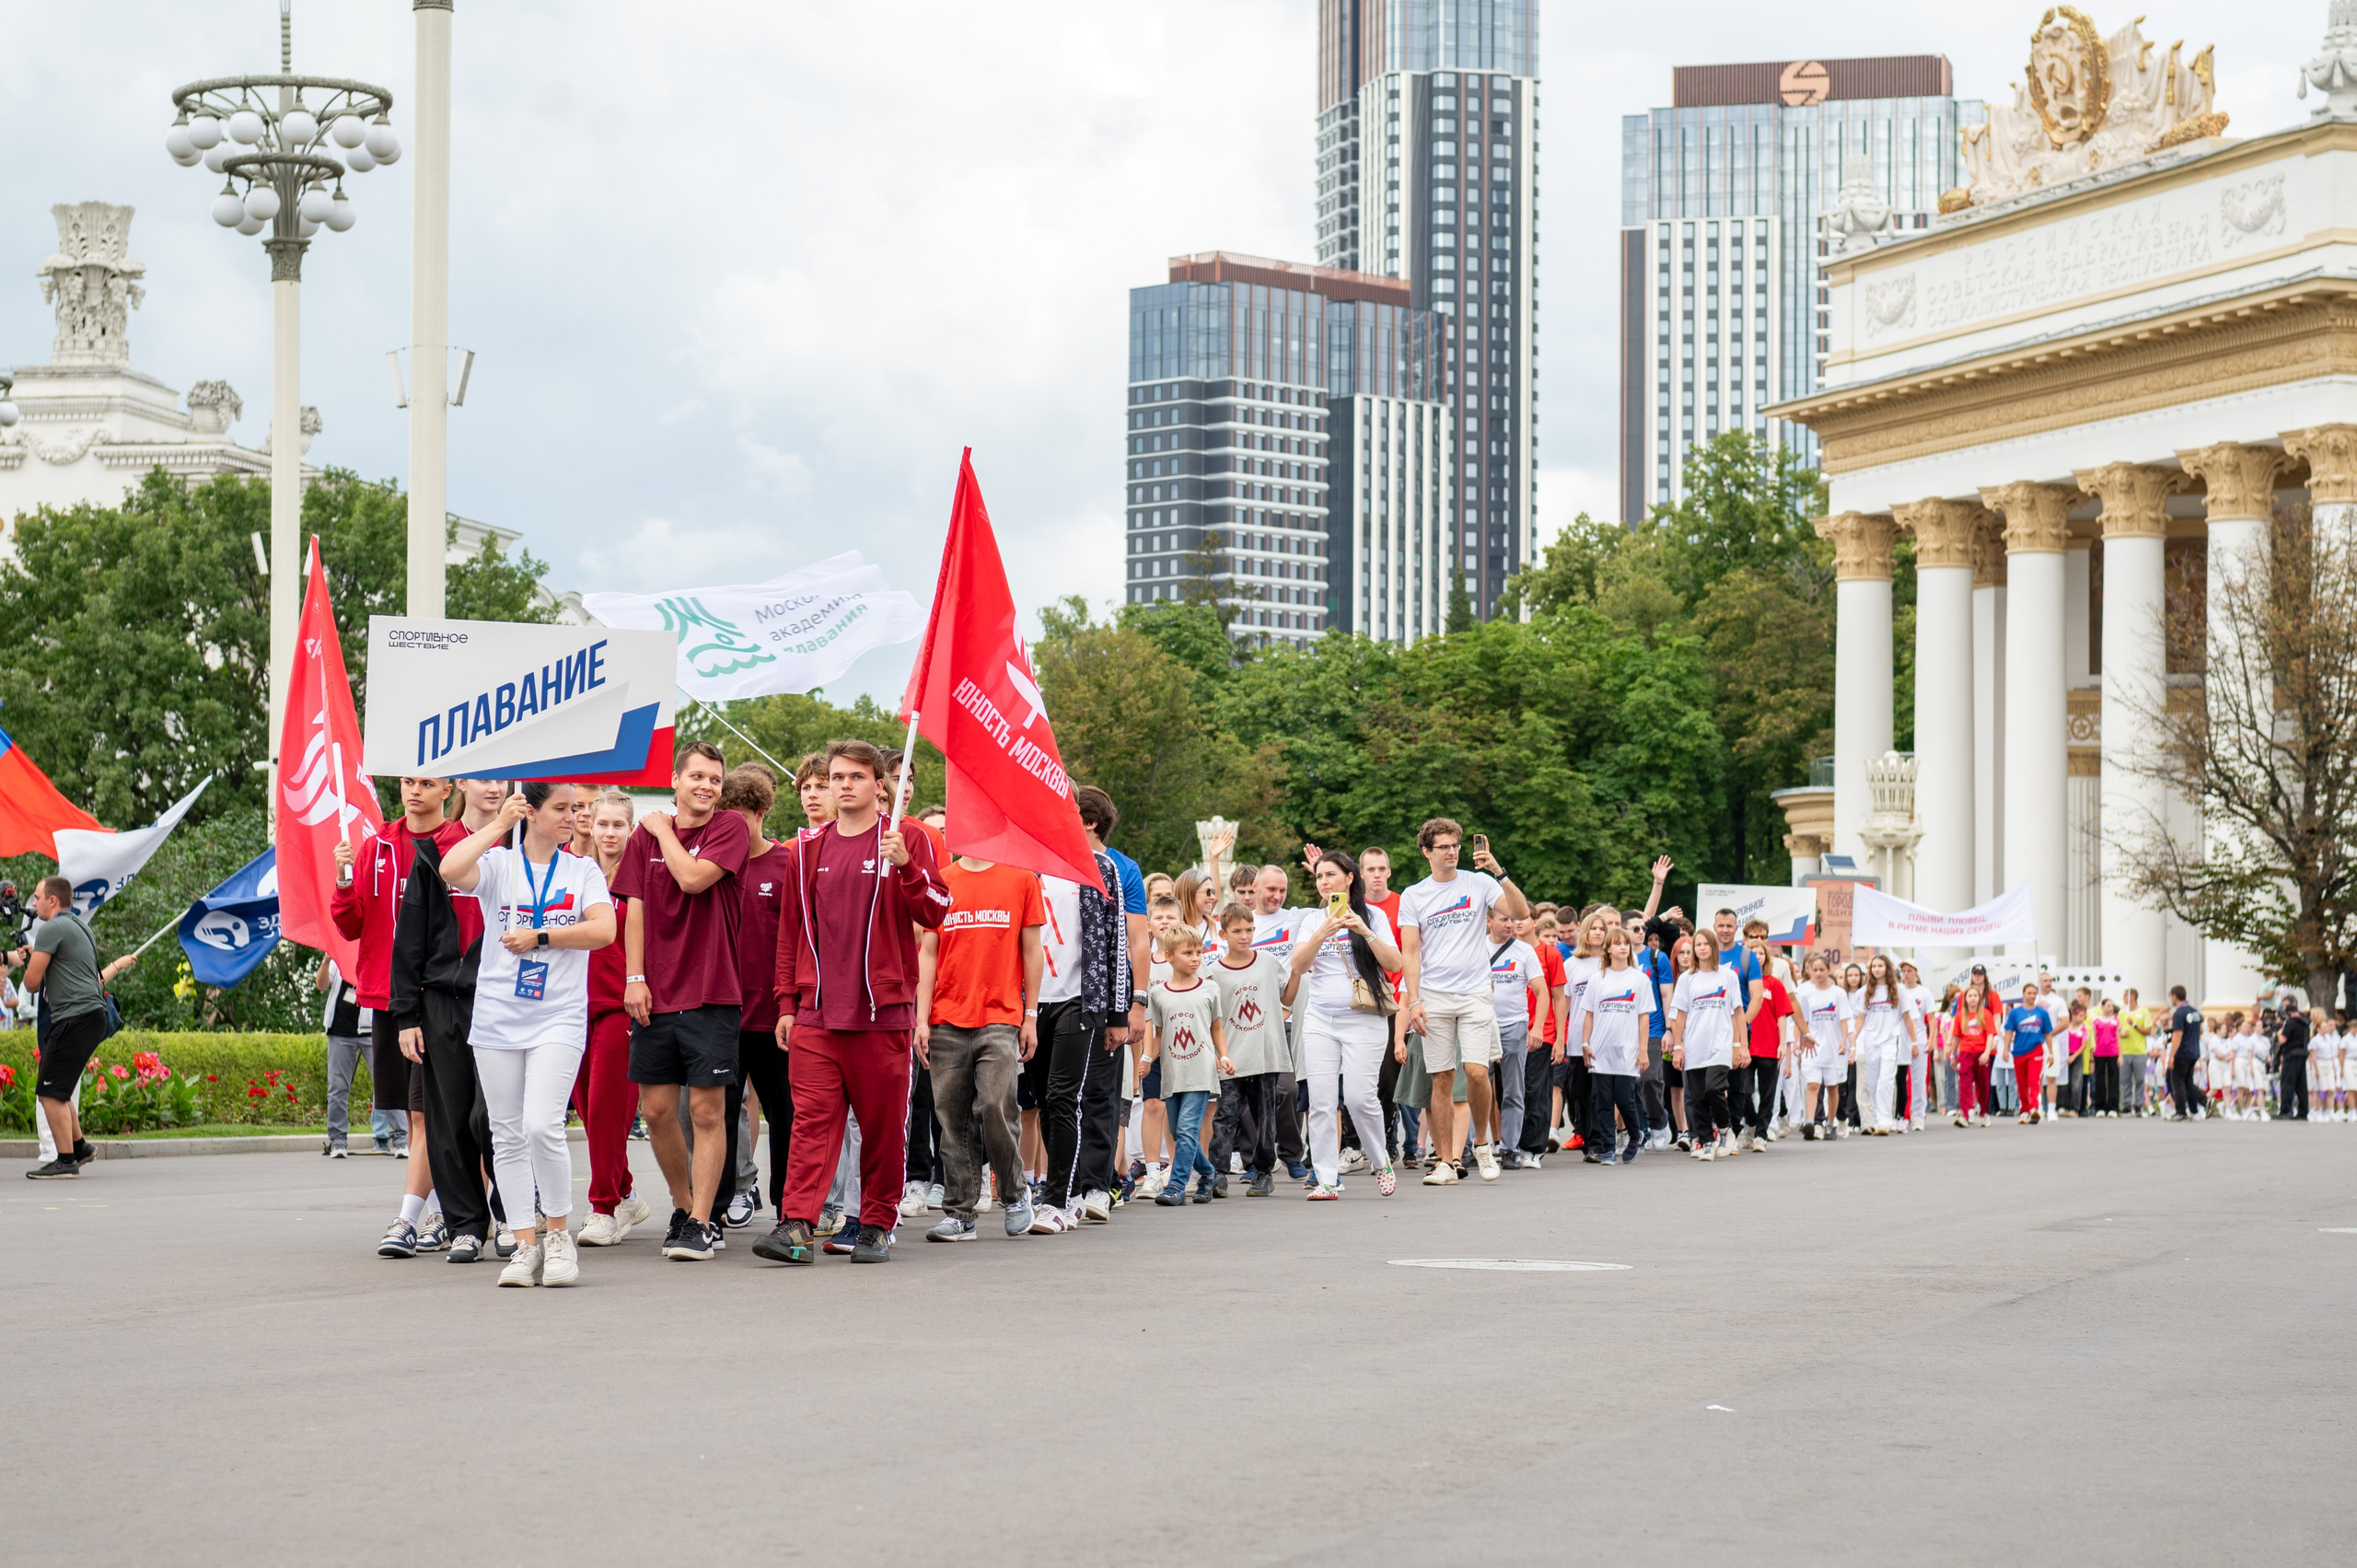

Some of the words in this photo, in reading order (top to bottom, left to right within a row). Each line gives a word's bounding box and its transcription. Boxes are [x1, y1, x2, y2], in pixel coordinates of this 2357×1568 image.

[388, 642, 449, 650] ШЕСТВИЕ
[417, 639, 608, 767] ПЛАВАНИЕ
[951, 677, 1011, 749] ЮНОСТЬ
[1008, 736, 1070, 799] МОСКВЫ
[1735, 897, 1766, 919] РОННОЕ
[975, 910, 1010, 923] МОСКВЫ
[1897, 922, 1928, 933] РИТМЕ
[1993, 973, 2020, 993] АТЛОН
[1169, 1012, 1195, 1022] МГФСО
